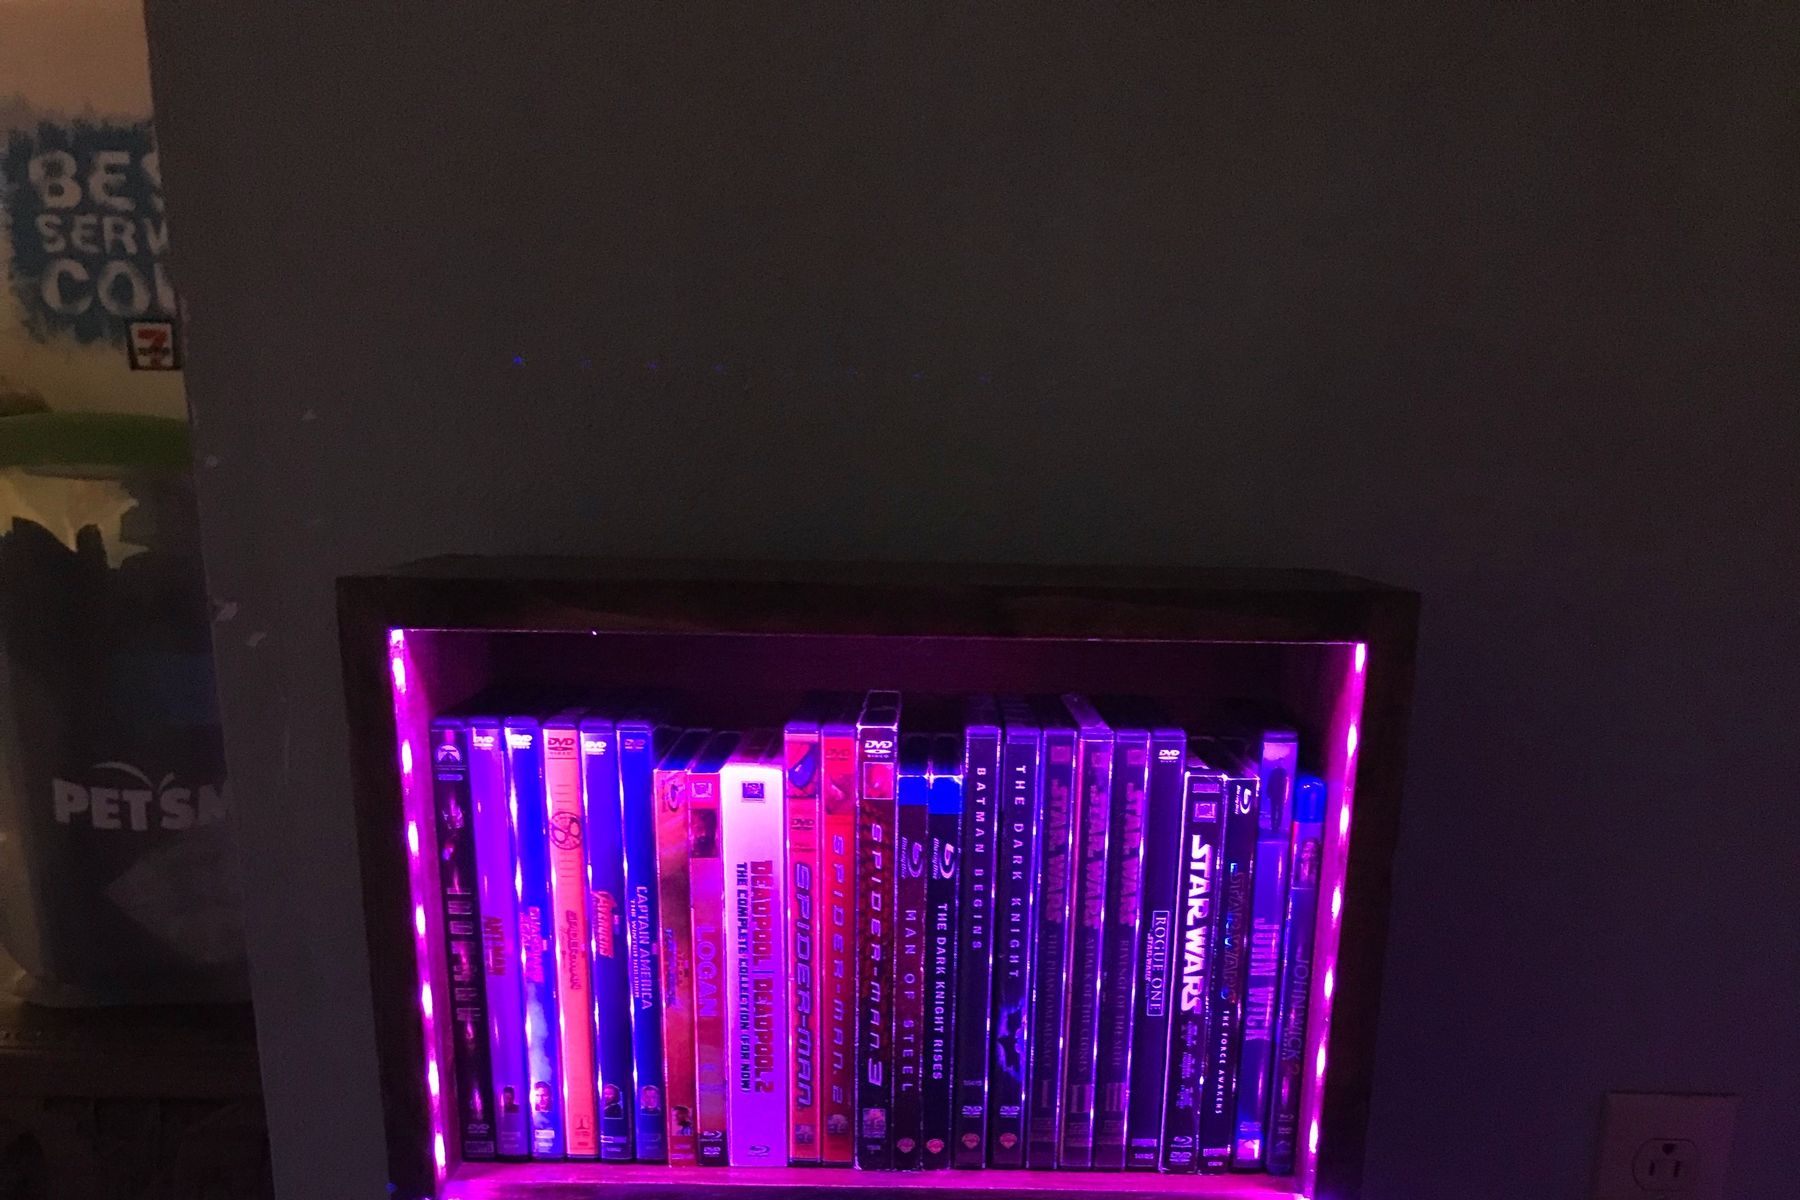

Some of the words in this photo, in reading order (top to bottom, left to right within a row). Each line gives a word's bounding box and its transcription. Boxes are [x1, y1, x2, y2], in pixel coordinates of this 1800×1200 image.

[548, 737, 575, 746] DVD
[864, 740, 893, 749] DVD
[975, 767, 987, 853] BATMAN
[1014, 766, 1026, 806] THE
[737, 862, 748, 886] THE
[1012, 823, 1024, 880] DARK
[1046, 854, 1065, 924] WARS
[1084, 860, 1104, 930] WARS
[1119, 857, 1138, 927] WARS
[1187, 834, 1212, 926] STAR
[636, 886, 650, 945] CAPTAIN
[737, 889, 749, 954] COMPLETE
[751, 860, 774, 966] DEADPOOL
[869, 823, 883, 1049] SPIDER-MAN
[904, 910, 917, 955] MAN
[937, 904, 948, 930] THE
[972, 869, 983, 949] BEGINS
[832, 834, 845, 1069] SPIDER-MAN
[935, 937, 947, 974] DARK
[1009, 898, 1022, 977] KNIGHT
[1152, 917, 1167, 972] ROGUE
[1252, 918, 1280, 976] JOHN
[639, 948, 653, 1010] AMERICA
[697, 926, 718, 1018] LOGAN
[738, 958, 750, 1031] COLLECTION
[795, 864, 811, 1106] SPIDER-MAN
[903, 973, 916, 1000] OF
[1150, 978, 1164, 1011] ONE
[1181, 927, 1208, 1014] WARS
[1292, 958, 1309, 1009] JOHN
[753, 978, 775, 1076] DEADPOOL
[934, 981, 945, 1033] KNIGHT
[1221, 1011, 1230, 1027] THE
[1245, 987, 1275, 1041] WICK
[902, 1020, 915, 1091] STEEL
[933, 1040, 944, 1079] RISES
[1218, 1033, 1229, 1065] FORCE
[1287, 1011, 1305, 1061] WICK
[740, 1063, 751, 1093] NOW)
[756, 1080, 774, 1093] 2
[832, 1085, 844, 1104] 2
[868, 1058, 882, 1087] 3
[1215, 1069, 1226, 1115] AWAKENS
